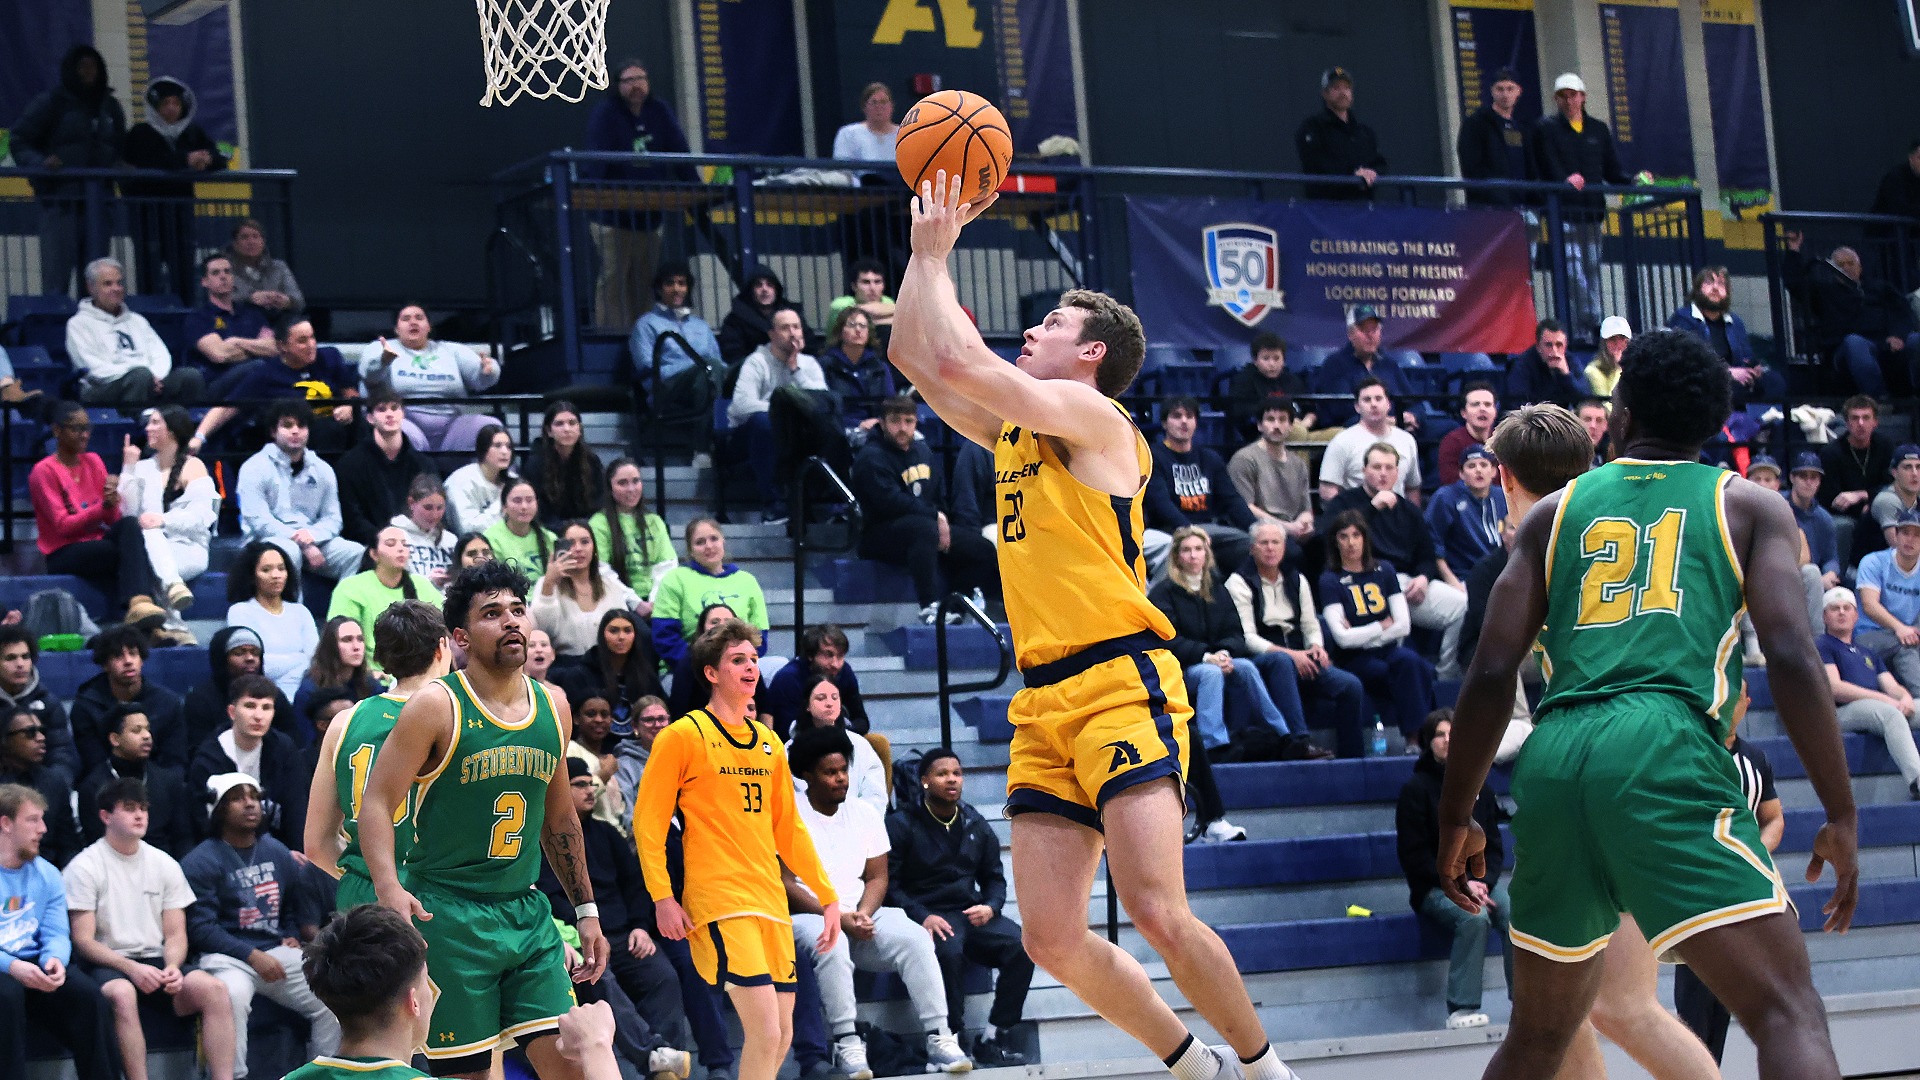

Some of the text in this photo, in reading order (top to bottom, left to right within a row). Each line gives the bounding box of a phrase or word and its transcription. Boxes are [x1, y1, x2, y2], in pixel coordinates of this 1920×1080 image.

[1310, 239, 1460, 258] CELEBRATING THE PAST.
[1221, 250, 1265, 287] 50
[1306, 262, 1469, 280] HONORING THE PRESENT.
[1325, 285, 1456, 302] LOOKING FORWARD
[1003, 489, 1026, 543] 20
[1573, 507, 1687, 631] 21
[1348, 582, 1386, 616] 13
[740, 782, 762, 813] 33
[487, 791, 527, 860] 2
